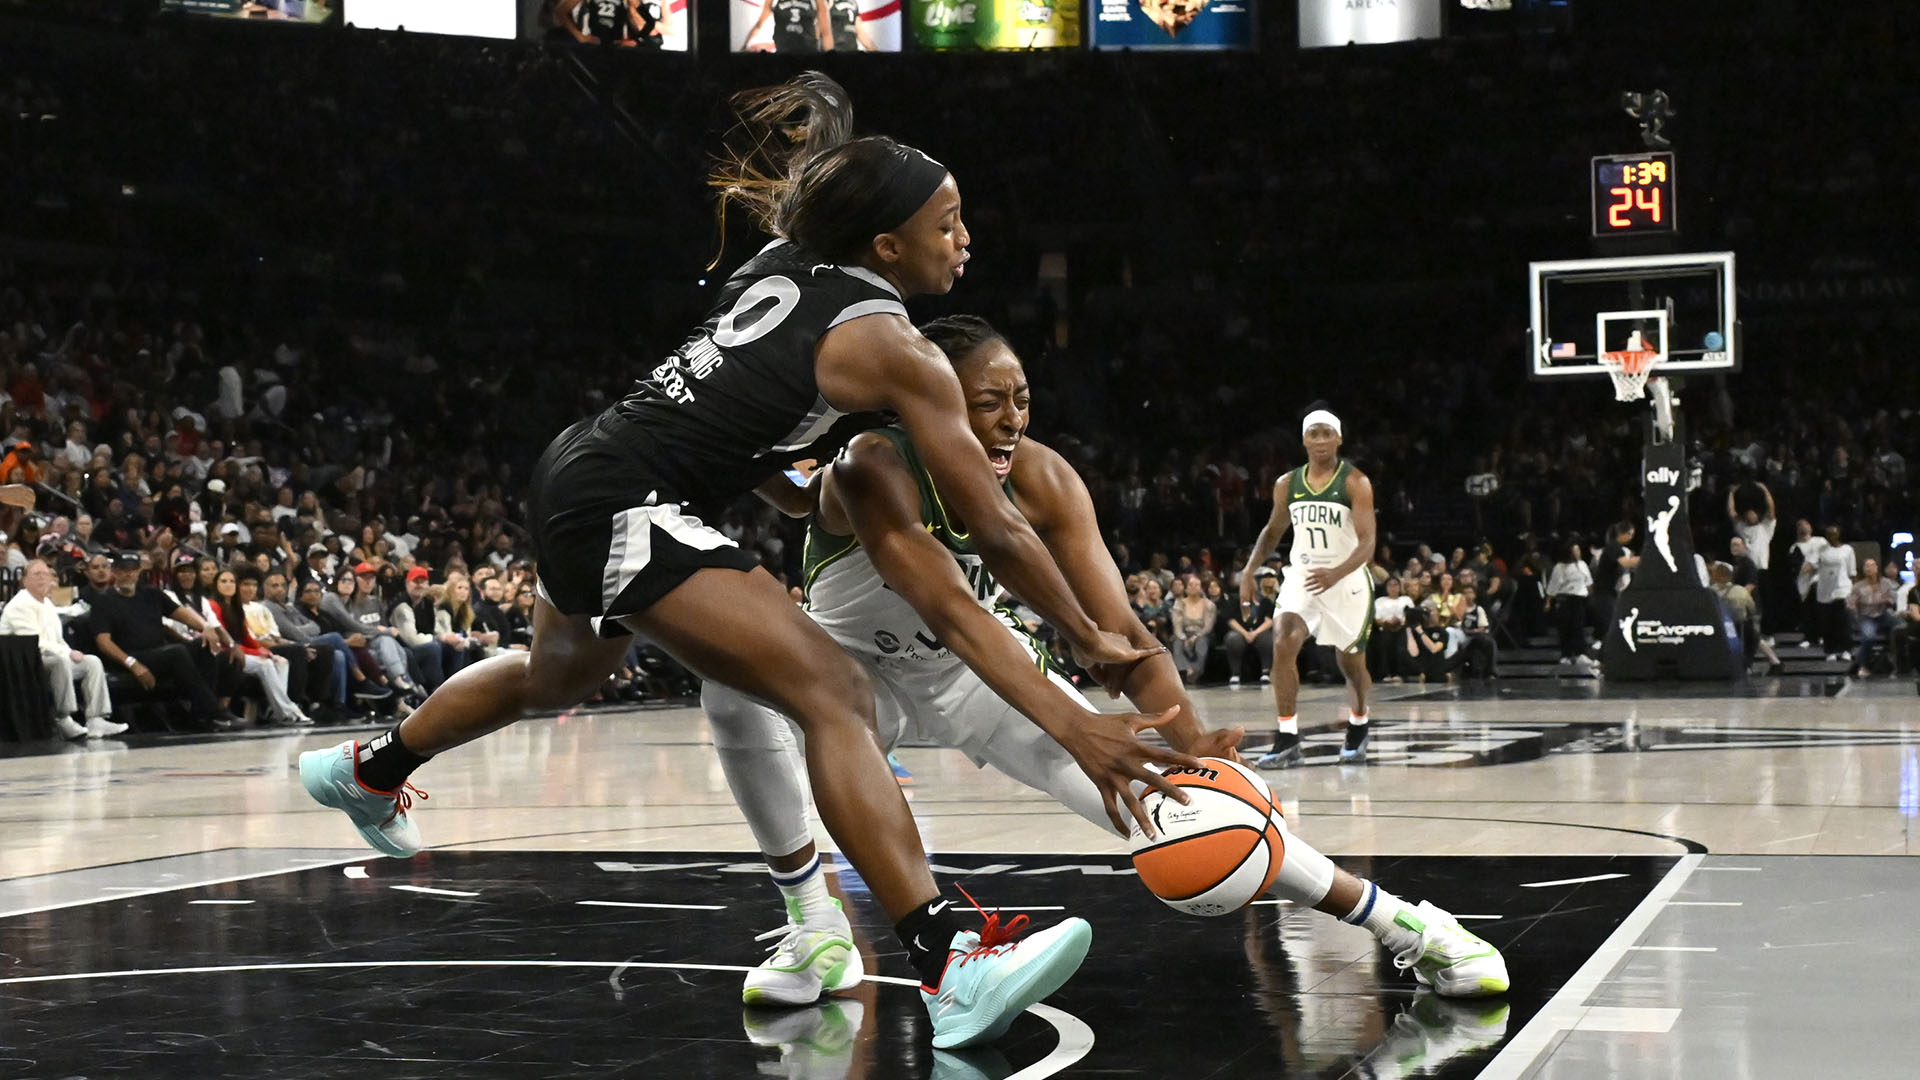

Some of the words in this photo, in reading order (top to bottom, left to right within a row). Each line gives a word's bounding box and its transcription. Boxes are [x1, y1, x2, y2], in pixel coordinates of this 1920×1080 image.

[1623, 161, 1666, 185] 1:39
[1609, 187, 1661, 227] 24
[712, 274, 801, 347] 0
[1647, 467, 1680, 486] ally
[1293, 504, 1342, 528] STORM
[1306, 527, 1328, 549] 17
[1637, 625, 1714, 636] PLAYOFFS
